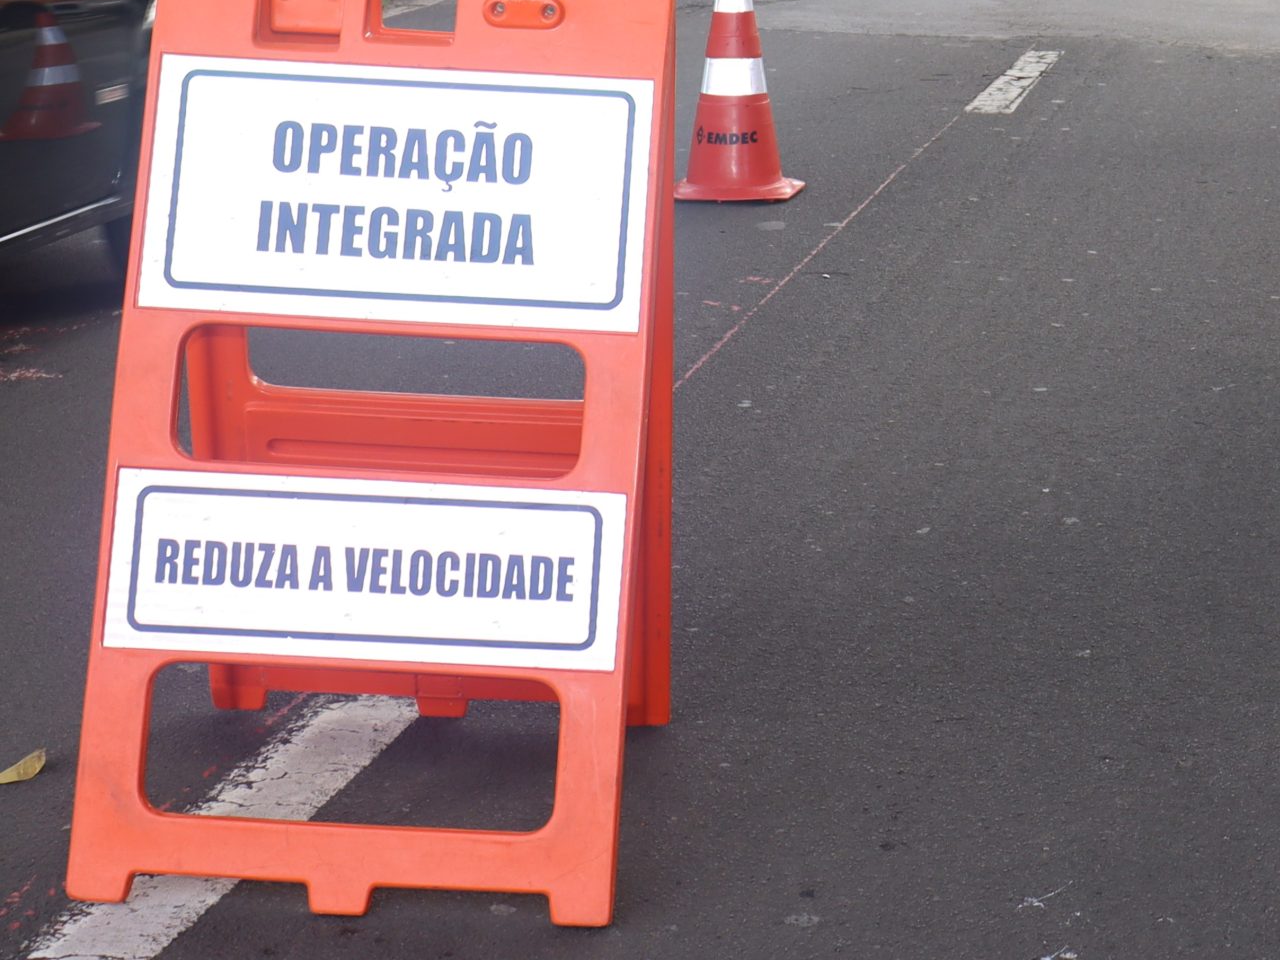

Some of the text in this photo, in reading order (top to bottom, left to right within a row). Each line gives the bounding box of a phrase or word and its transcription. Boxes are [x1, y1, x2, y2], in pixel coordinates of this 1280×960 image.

[272, 121, 533, 191] OPERAÇÃO
[707, 131, 758, 144] EMDEC
[257, 201, 534, 265] INTEGRADA
[155, 539, 575, 601] REDUZA A VELOCIDADE
